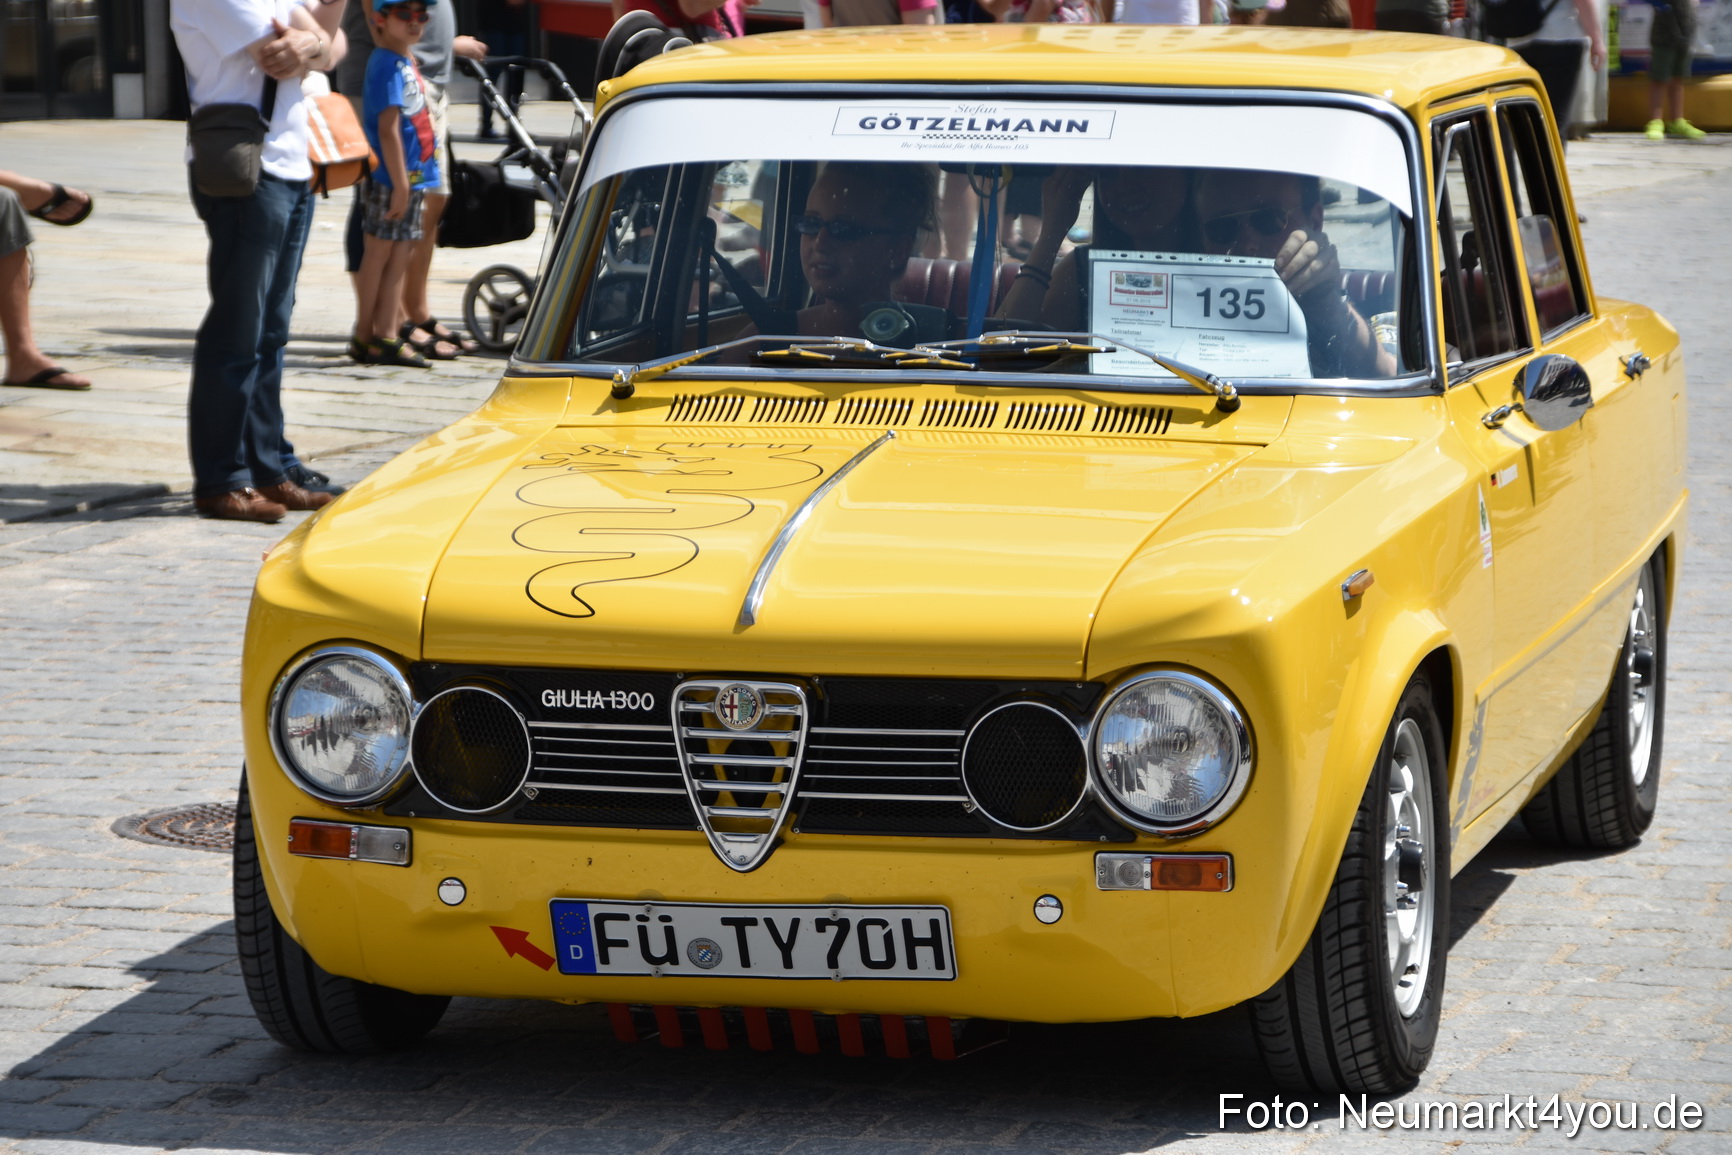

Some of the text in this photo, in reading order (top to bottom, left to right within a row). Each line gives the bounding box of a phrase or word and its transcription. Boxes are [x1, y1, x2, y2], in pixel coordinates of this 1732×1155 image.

[954, 103, 998, 115] Stefan
[858, 112, 1090, 133] GÖTZELMANN
[900, 141, 912, 149] Ihr
[914, 141, 952, 150] Spezialist
[953, 141, 965, 150] für
[967, 142, 983, 151] Alfa
[985, 142, 1012, 150] Romeo
[1196, 286, 1266, 320] 135
[1111, 328, 1142, 336] Teilnehmer
[1198, 333, 1225, 341] Fahrzeug
[541, 689, 655, 711] GIULIA 1300
[726, 716, 752, 726] MILANO
[593, 912, 680, 967] FÜ
[570, 944, 583, 960] D
